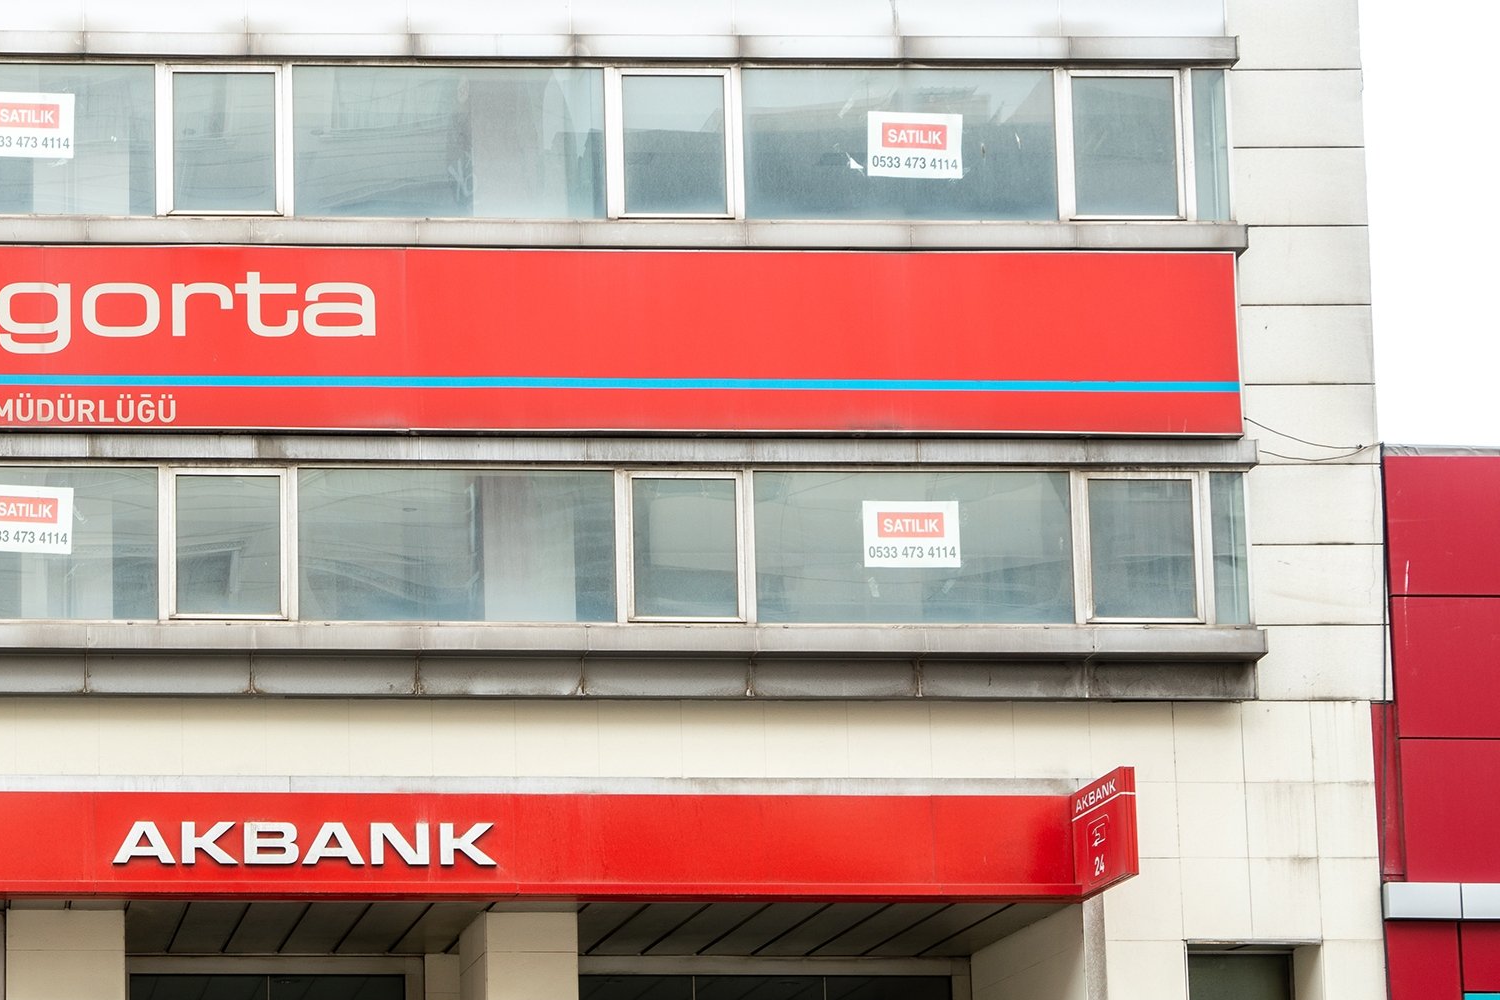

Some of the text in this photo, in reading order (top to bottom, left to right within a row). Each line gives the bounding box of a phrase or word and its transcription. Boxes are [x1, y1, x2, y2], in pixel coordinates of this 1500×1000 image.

[0, 108, 54, 124] SATILIK
[16, 136, 38, 148] 473
[41, 137, 70, 149] 4114
[888, 129, 942, 144] SATILIK
[872, 155, 958, 170] 0533 473 4114
[883, 518, 939, 533] SATILIK
[13, 530, 35, 543] 473
[39, 531, 68, 544] 4114
[868, 546, 956, 558] 0533 473 4114
[1075, 778, 1117, 813] AKBANK
[113, 821, 497, 868] AKBANK
[1094, 853, 1105, 877] 24
